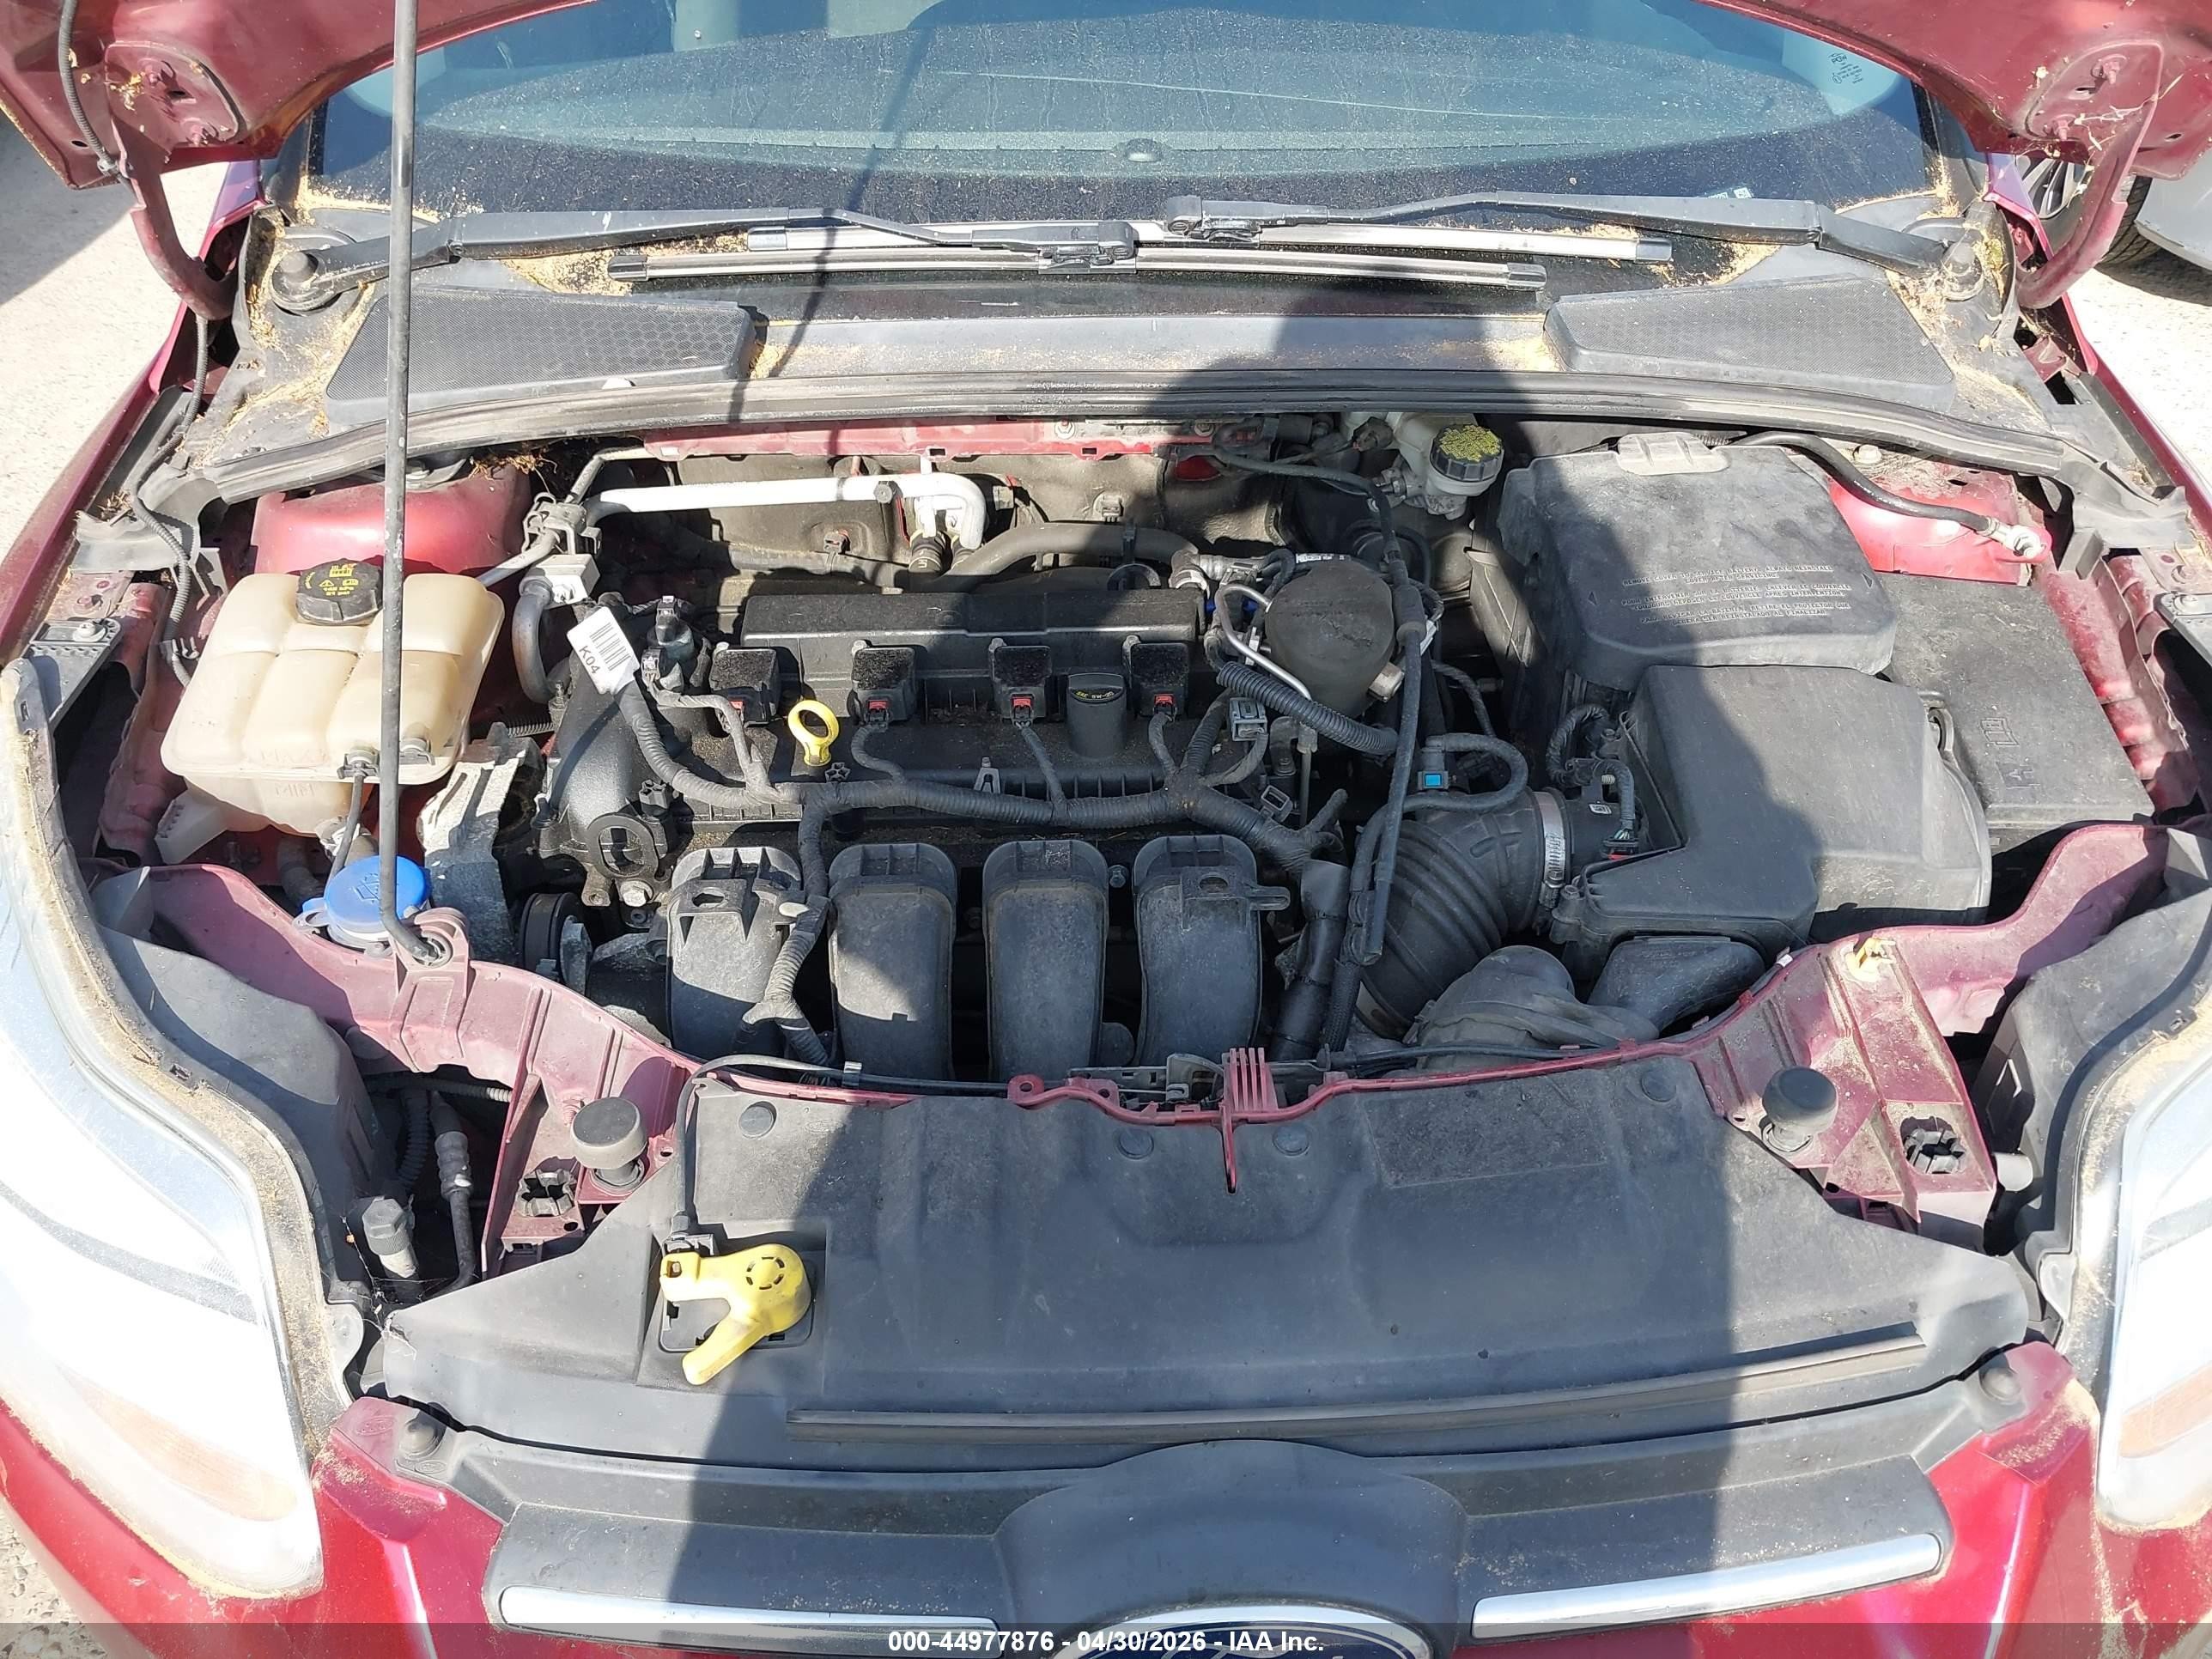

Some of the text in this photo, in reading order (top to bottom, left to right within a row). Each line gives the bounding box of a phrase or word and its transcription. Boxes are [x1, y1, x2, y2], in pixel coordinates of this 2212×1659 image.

[1623, 576, 1650, 586] REMOVE
[1693, 568, 1725, 577] SERVICE
[1794, 564, 1834, 573] REINSTALL
[1685, 576, 1710, 585] COVER
[1711, 574, 1733, 582] AFTER
[1621, 598, 1640, 606] POUR
[1644, 592, 1690, 603] INTERVENIR
[1634, 602, 1670, 611] TOUJOURS
[1673, 597, 1705, 605] REPOSER
[1721, 592, 1762, 600] COUVERCLE
[1663, 611, 1695, 619] REVISAR
[1750, 603, 1779, 611] RETIRE
[1835, 601, 1851, 610] QUE
[1721, 611, 1771, 620] REINSTALADO
[579, 645, 600, 674] K04
